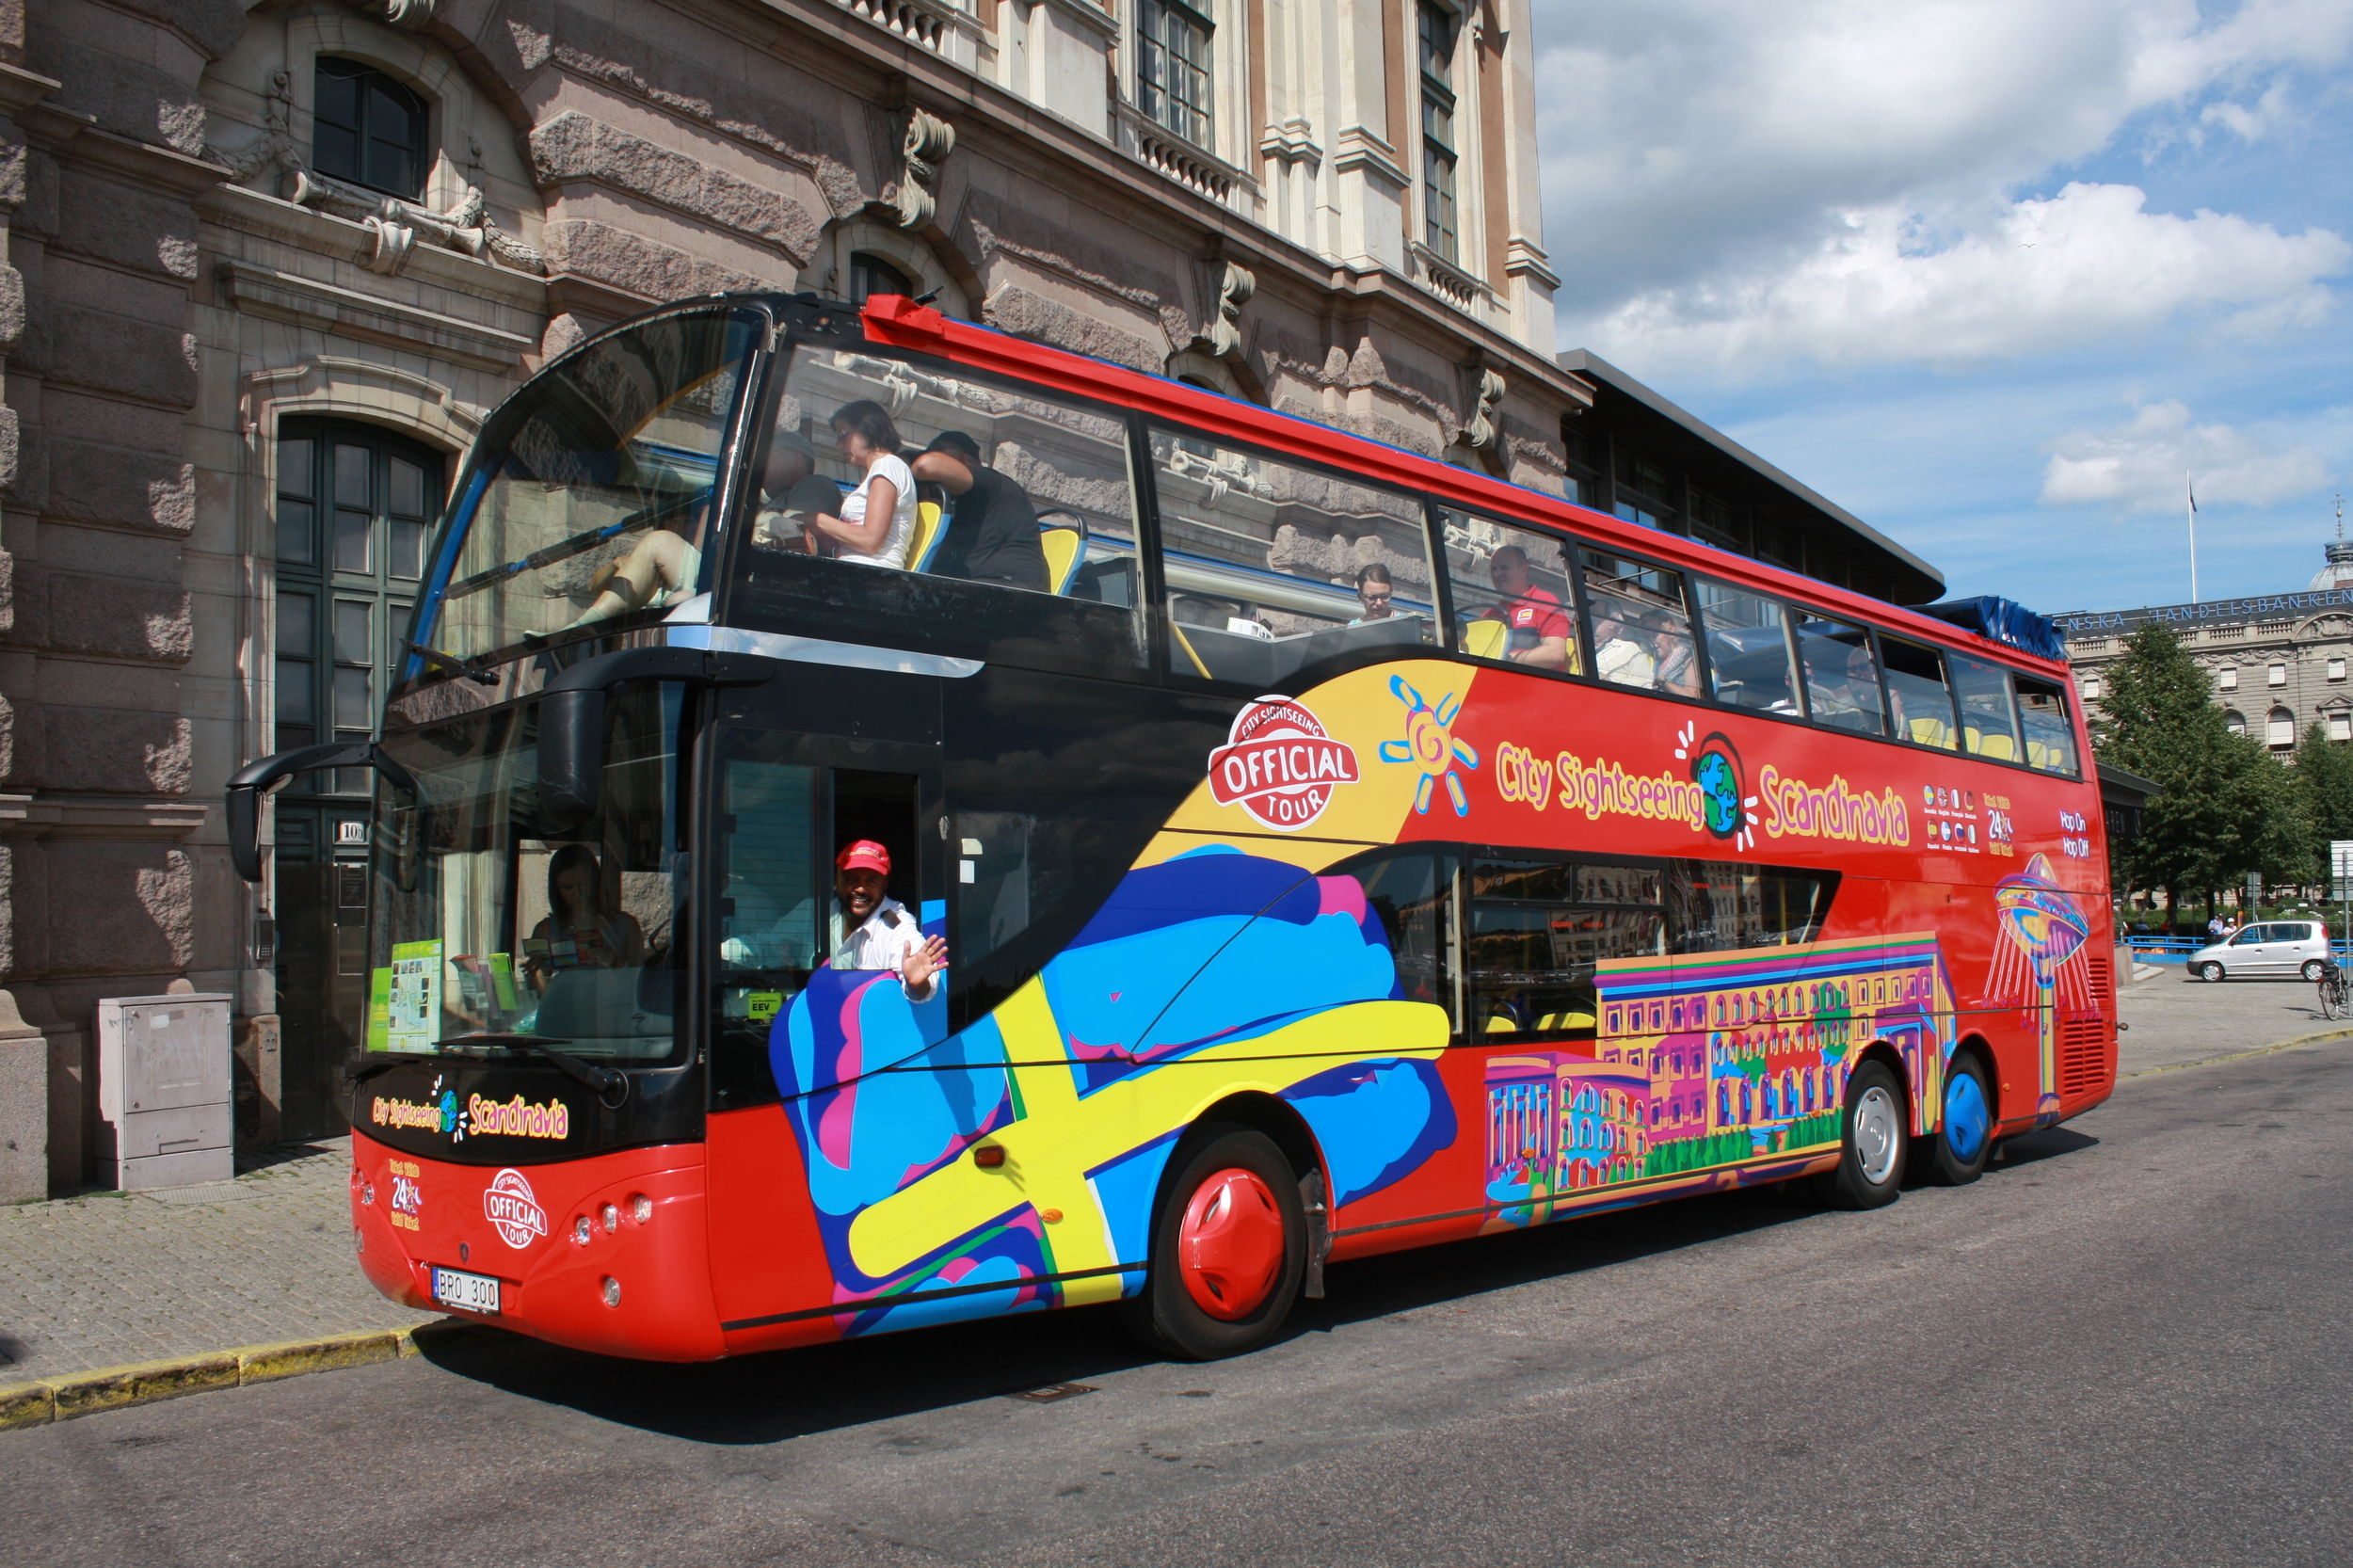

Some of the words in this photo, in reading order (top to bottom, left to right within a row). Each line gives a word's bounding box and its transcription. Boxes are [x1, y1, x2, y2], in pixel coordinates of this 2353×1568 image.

[1241, 712, 1259, 740] CITY
[1261, 706, 1321, 738] SIGHTSEEING
[1225, 745, 1352, 793] OFFICIAL
[1267, 789, 1324, 822] TOUR
[1496, 741, 1553, 811] City
[1558, 750, 1705, 831] Sightseeing
[1759, 764, 1910, 847] Scandinavia
[2059, 810, 2075, 833] Hop
[2075, 812, 2087, 832] On
[2063, 837, 2077, 858] Hop
[2078, 838, 2089, 857] Off
[373, 1096, 389, 1127] City
[389, 1097, 441, 1133] Sightseeing
[469, 1093, 568, 1140] Scandinavia
[490, 1195, 543, 1231] OFFICIAL
[505, 1224, 529, 1243] TOUR
[440, 1273, 462, 1299] BRO
[472, 1280, 496, 1305] 300
